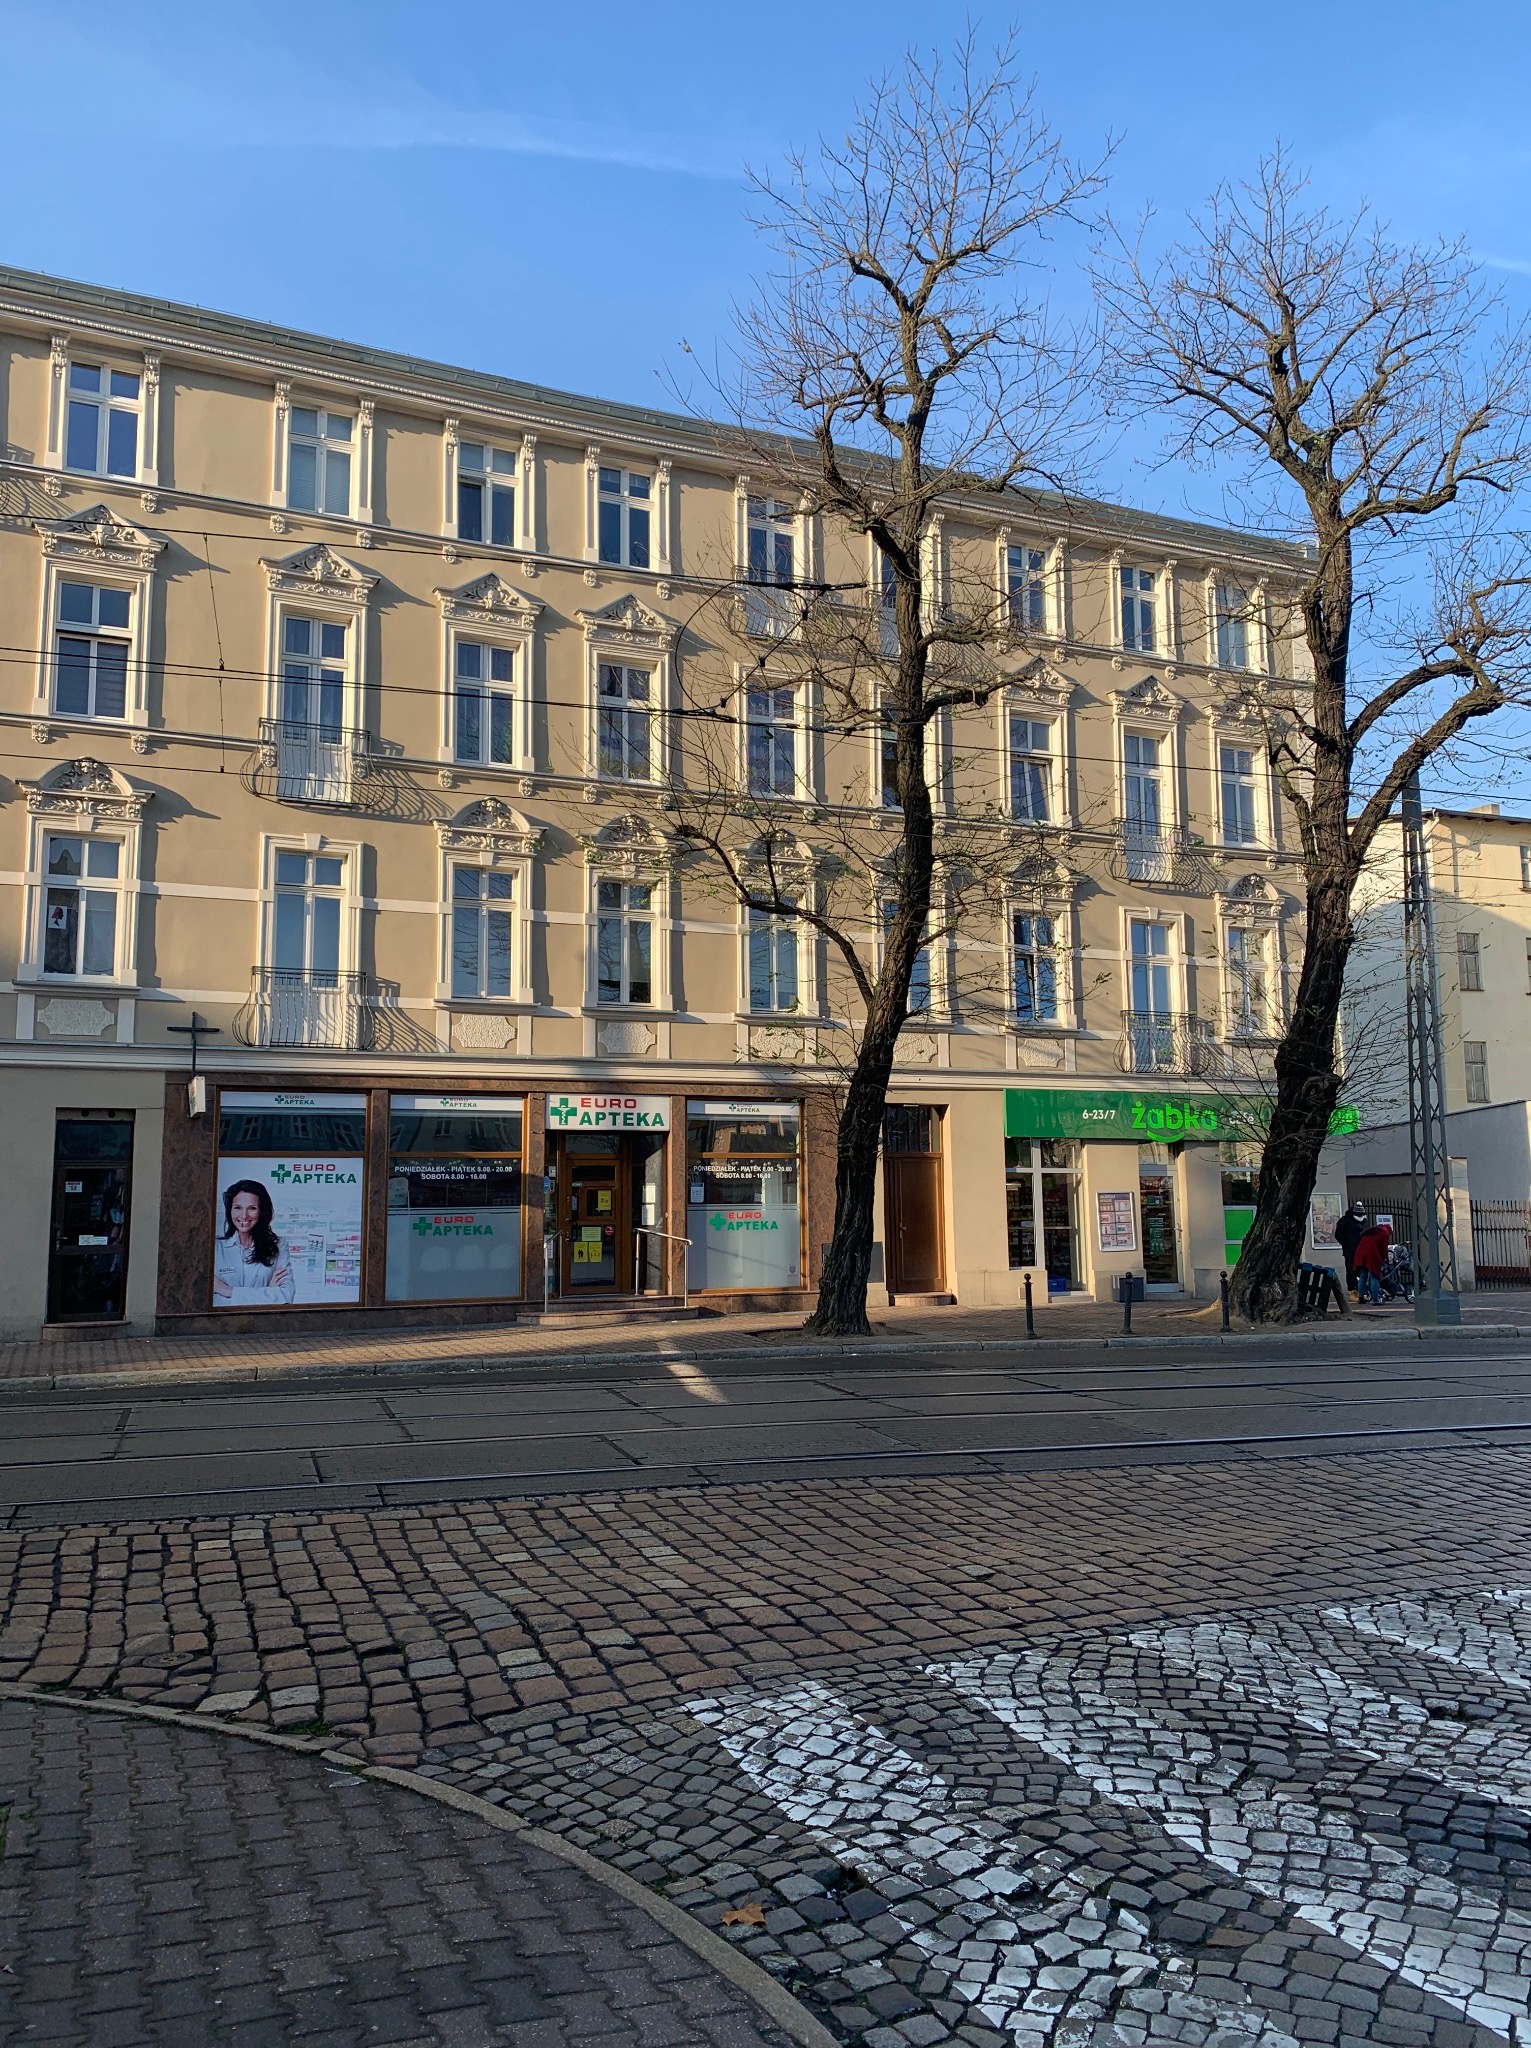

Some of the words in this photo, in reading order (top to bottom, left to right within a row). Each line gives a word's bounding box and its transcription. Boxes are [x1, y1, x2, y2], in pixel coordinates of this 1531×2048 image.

[580, 1098, 637, 1108] EURO
[579, 1112, 665, 1126] APTEKA
[1082, 1109, 1116, 1120] 6-23/7
[451, 1166, 476, 1174] PIĄTEK
[292, 1174, 356, 1184] APTEKA
[727, 1220, 778, 1230] APTEKA
[432, 1225, 494, 1236] APTEKA
